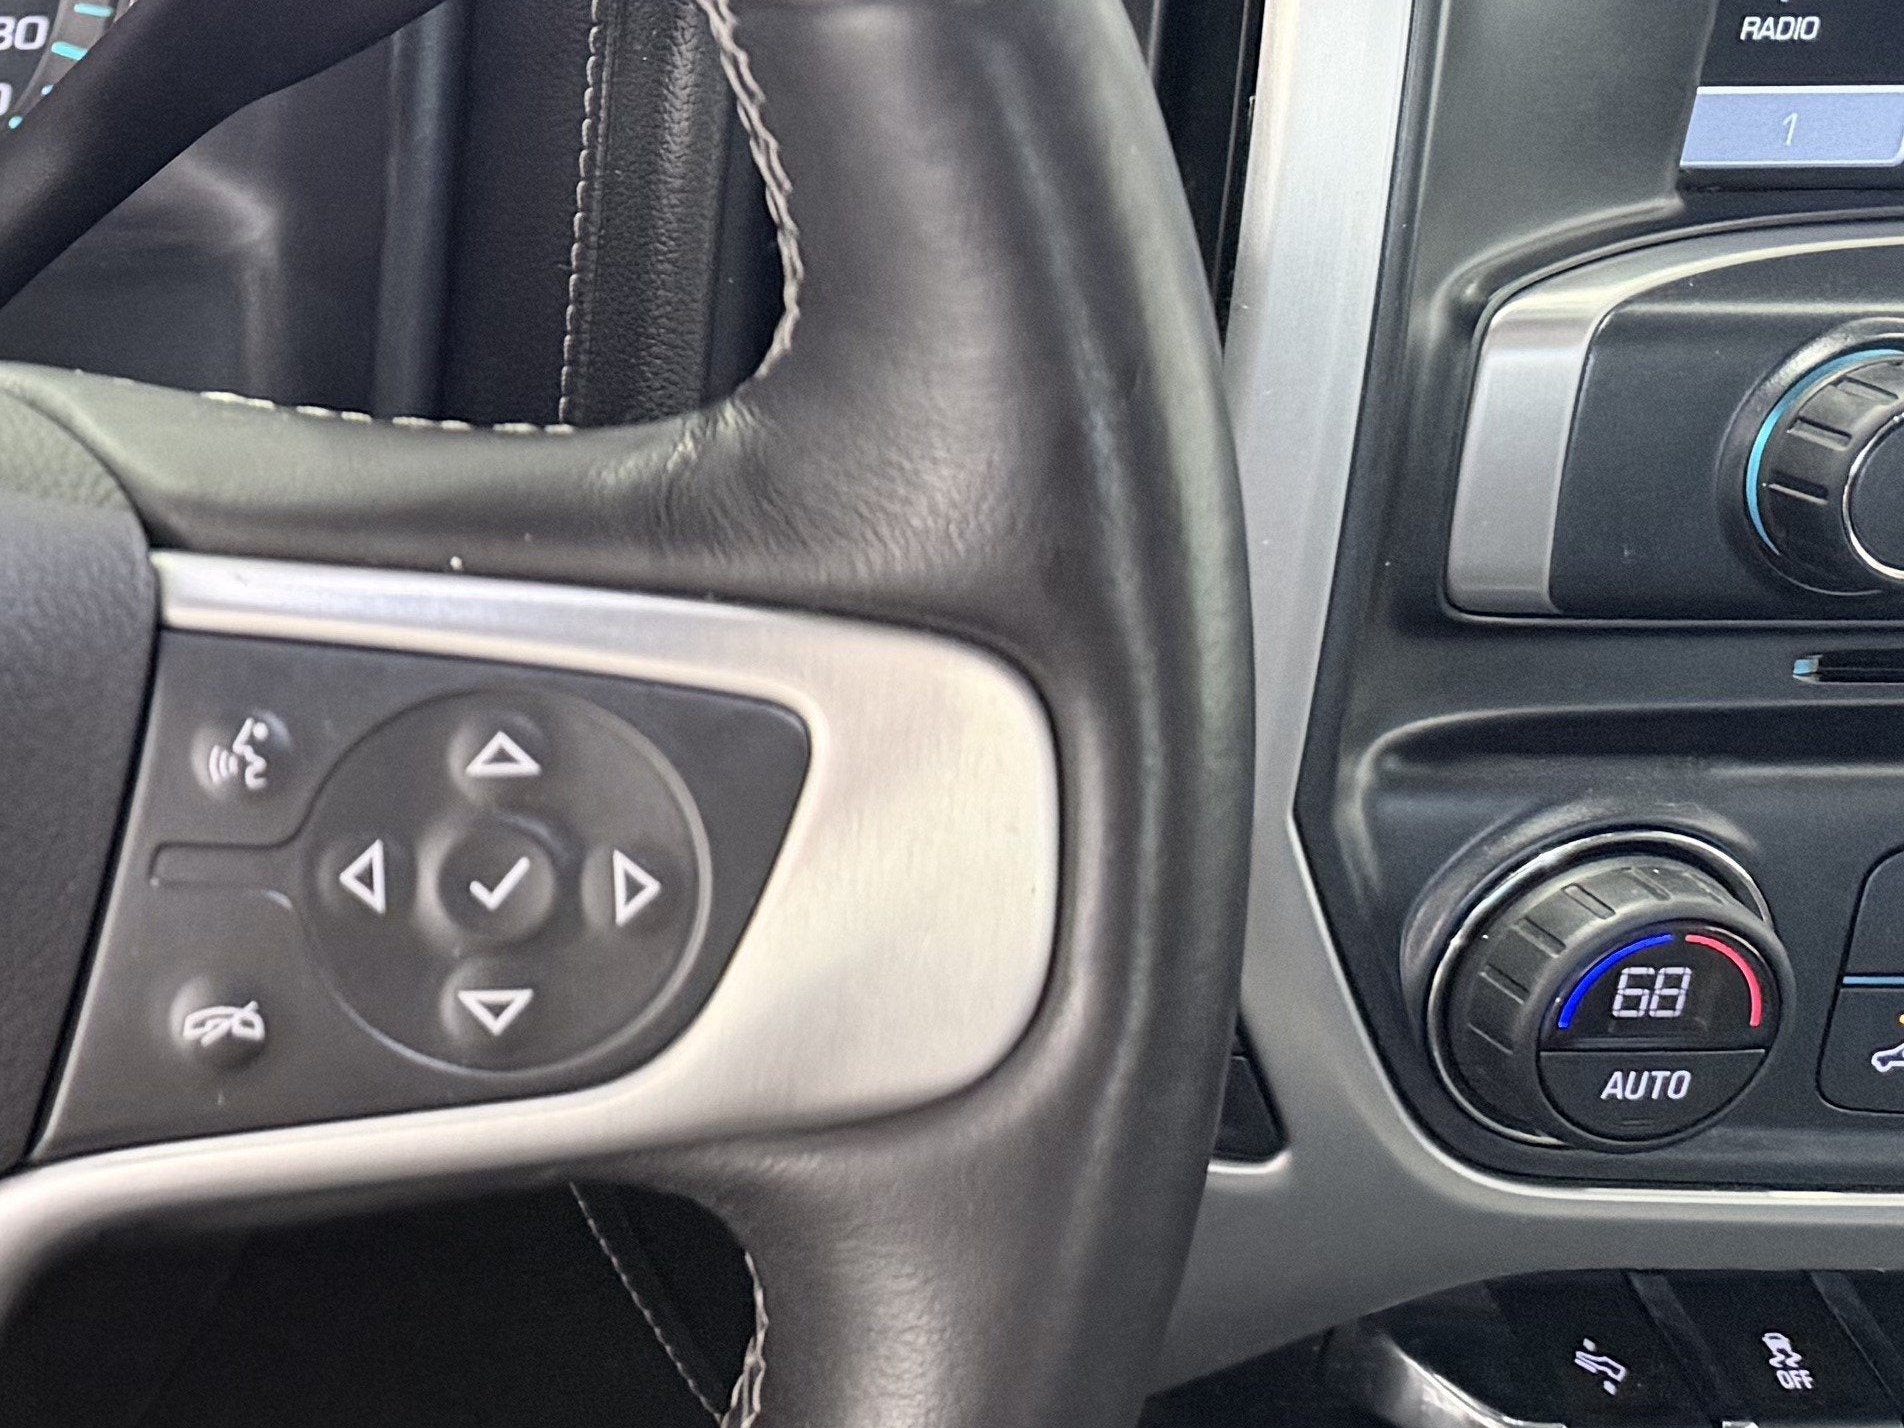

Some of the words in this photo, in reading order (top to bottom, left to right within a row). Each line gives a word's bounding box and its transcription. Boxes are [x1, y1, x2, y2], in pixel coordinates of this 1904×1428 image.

[1739, 15, 1821, 41] RADIO
[1611, 966, 1693, 1018] 68
[1600, 1069, 1692, 1101] AUTO
[1776, 1369, 1814, 1390] OFF
